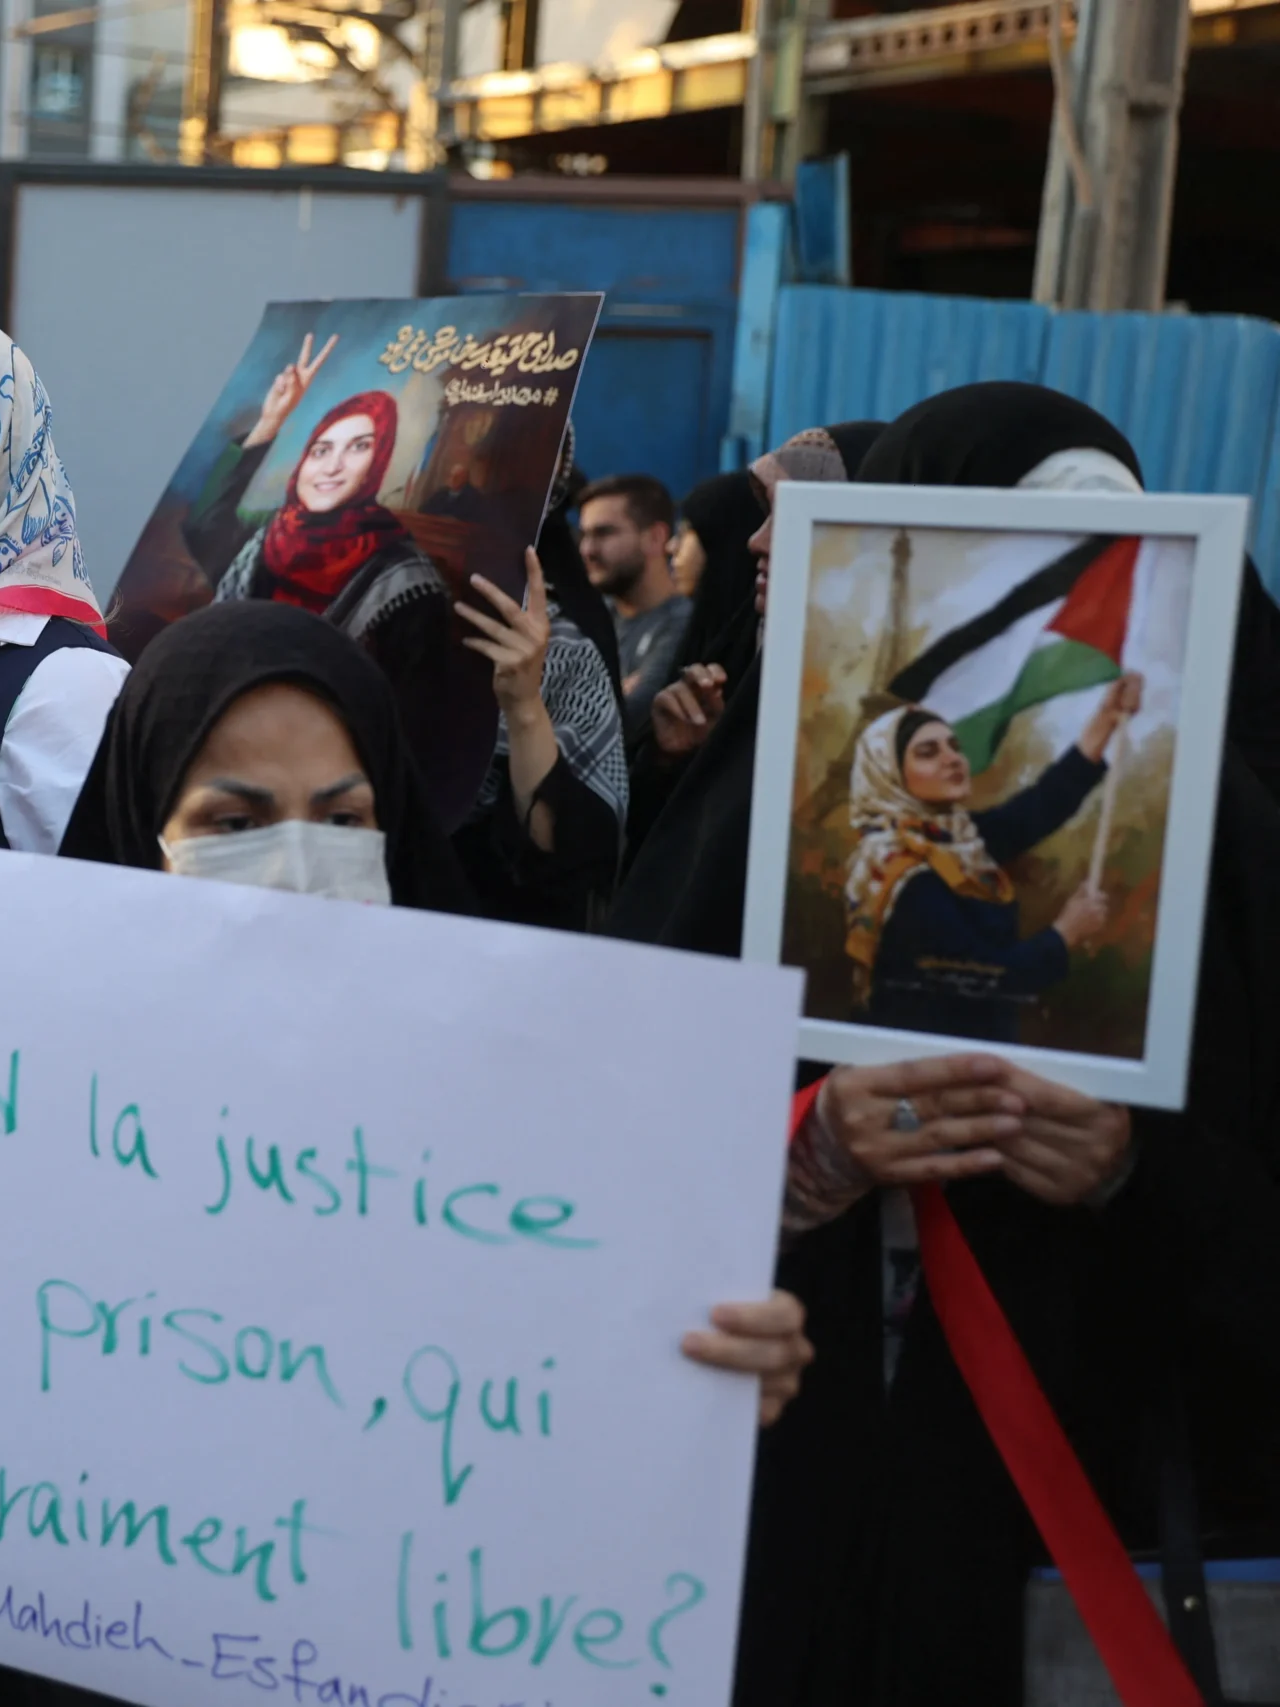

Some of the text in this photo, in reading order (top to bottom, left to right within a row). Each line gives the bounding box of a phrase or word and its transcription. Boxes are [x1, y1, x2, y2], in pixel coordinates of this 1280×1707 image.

[87, 1069, 163, 1183] la
[202, 1104, 606, 1252] justice
[399, 1343, 559, 1510] qui
[394, 1528, 709, 1701] libre?
